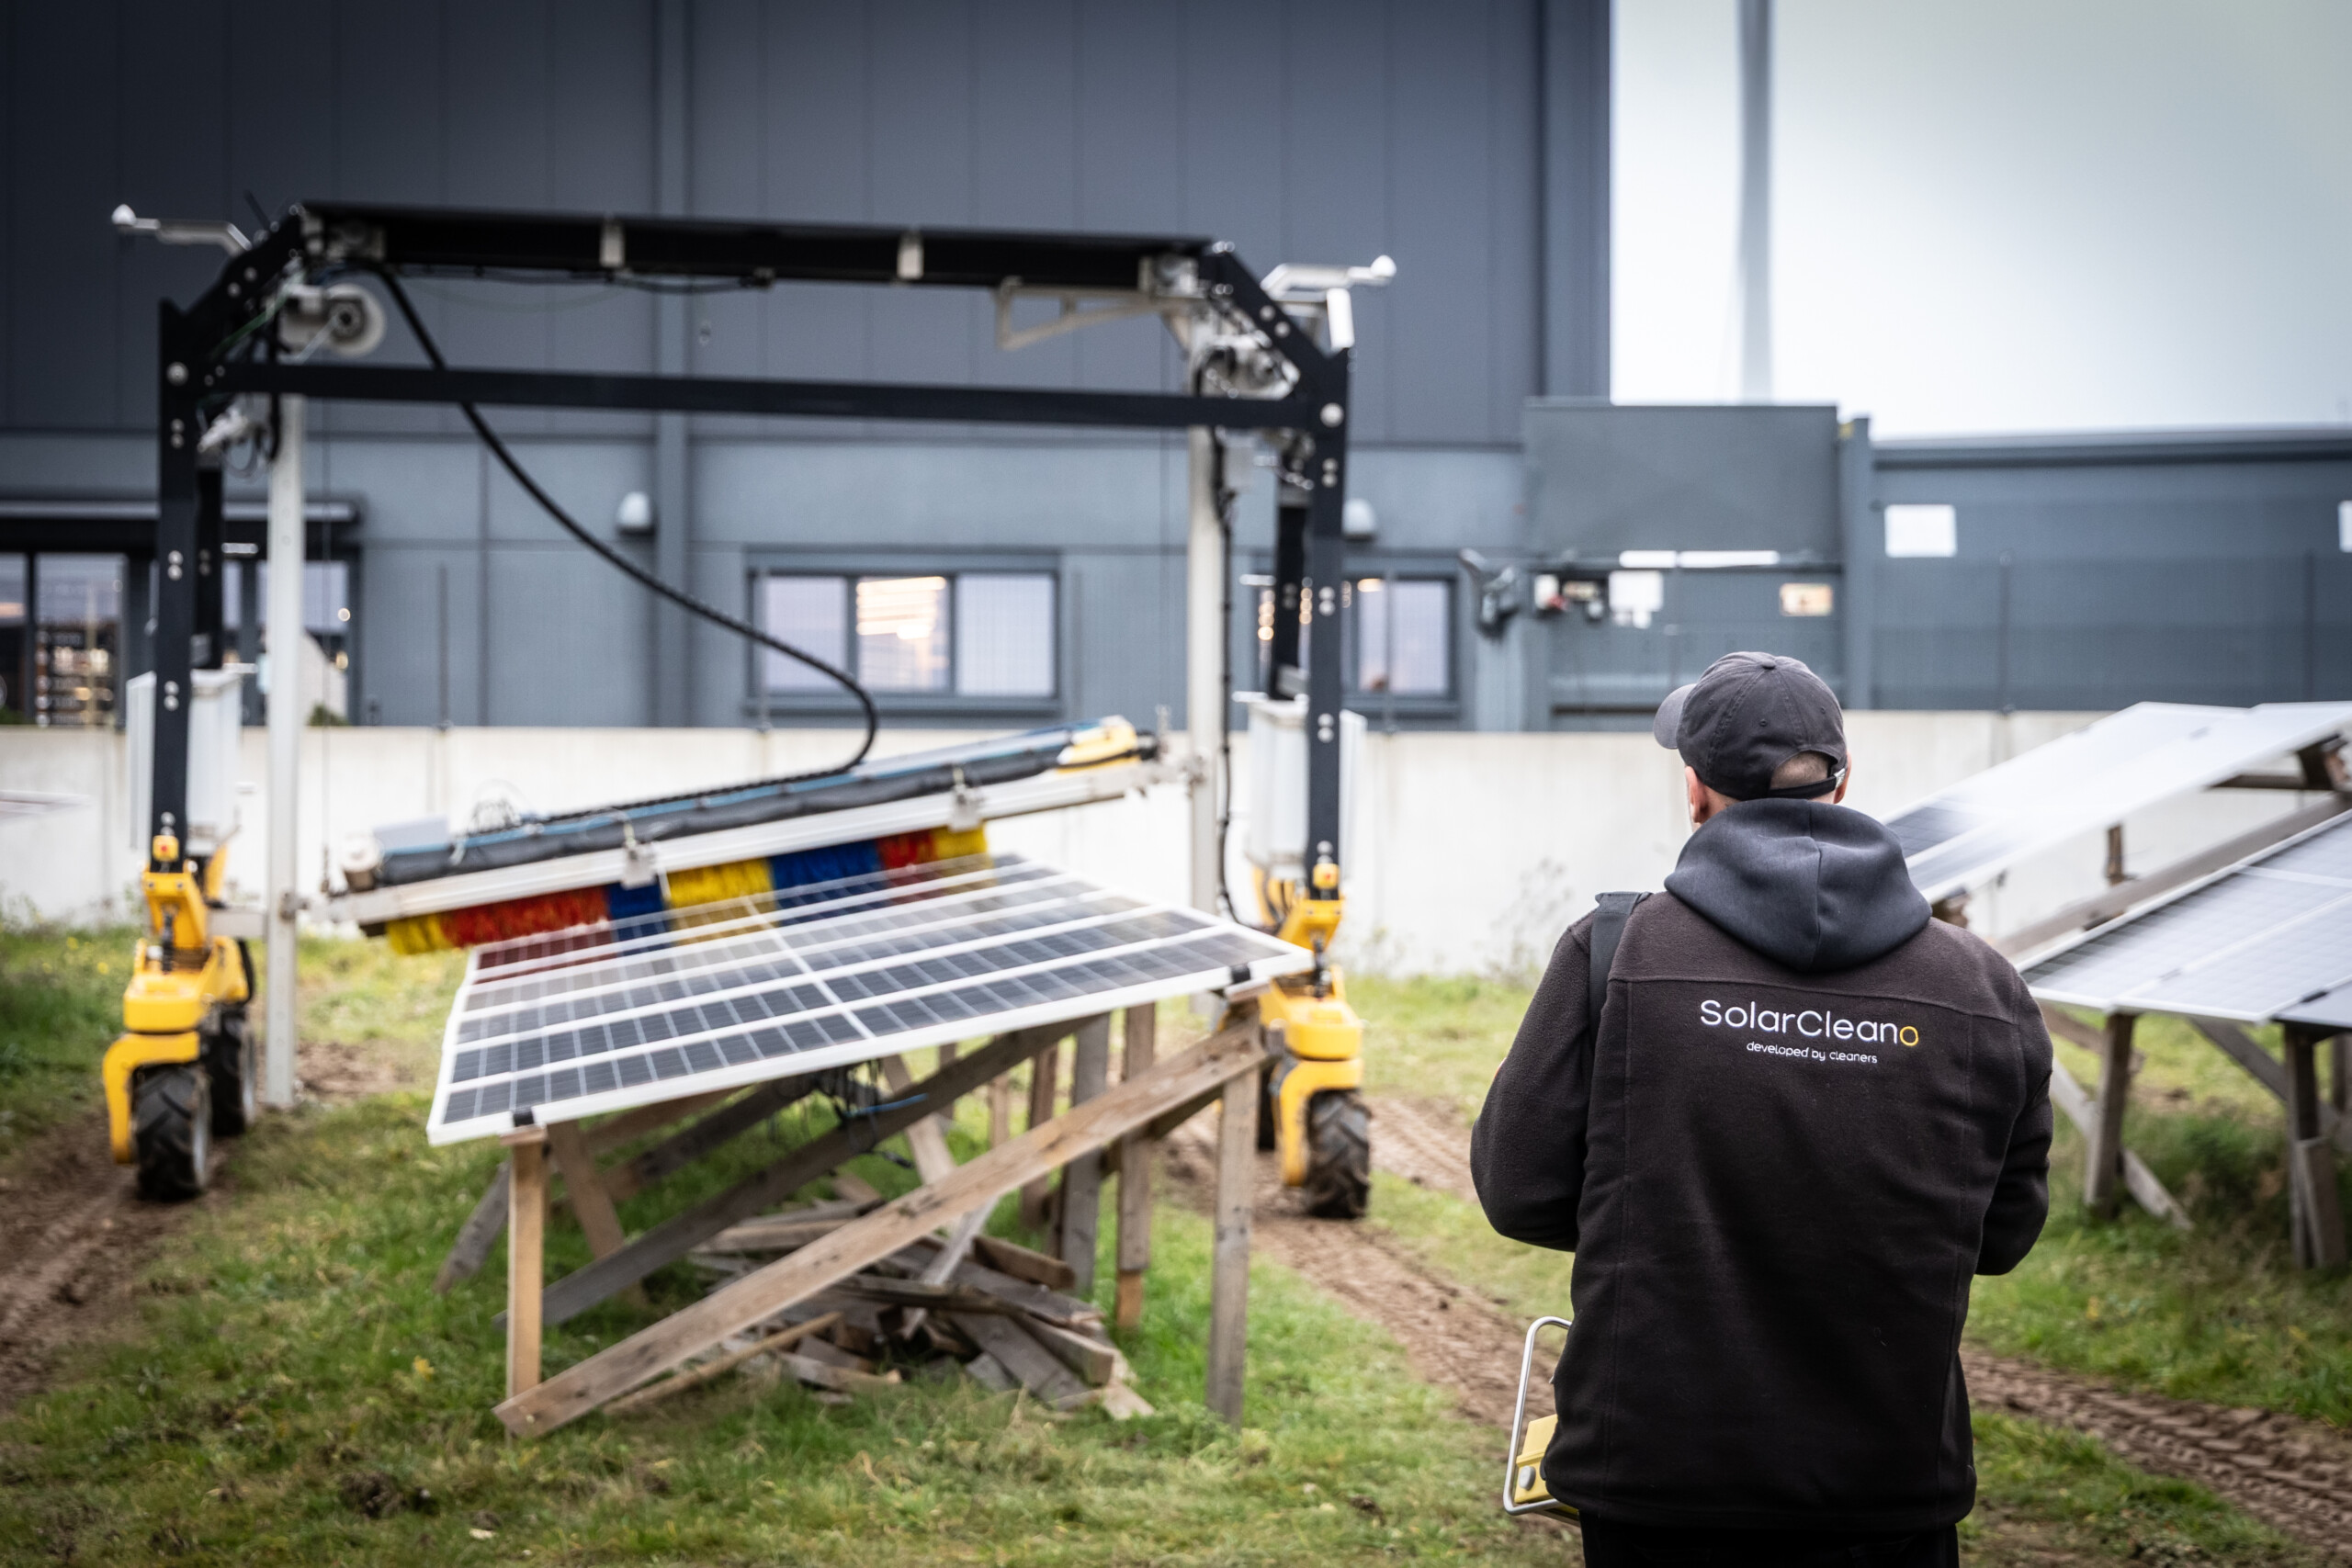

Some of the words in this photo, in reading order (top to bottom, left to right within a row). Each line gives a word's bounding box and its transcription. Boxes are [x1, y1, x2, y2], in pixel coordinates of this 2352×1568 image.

[1700, 999, 1919, 1047] SolarCleano
[1747, 1041, 1809, 1058] developed
[1811, 1049, 1826, 1062] by
[1829, 1050, 1878, 1064] cleaners
